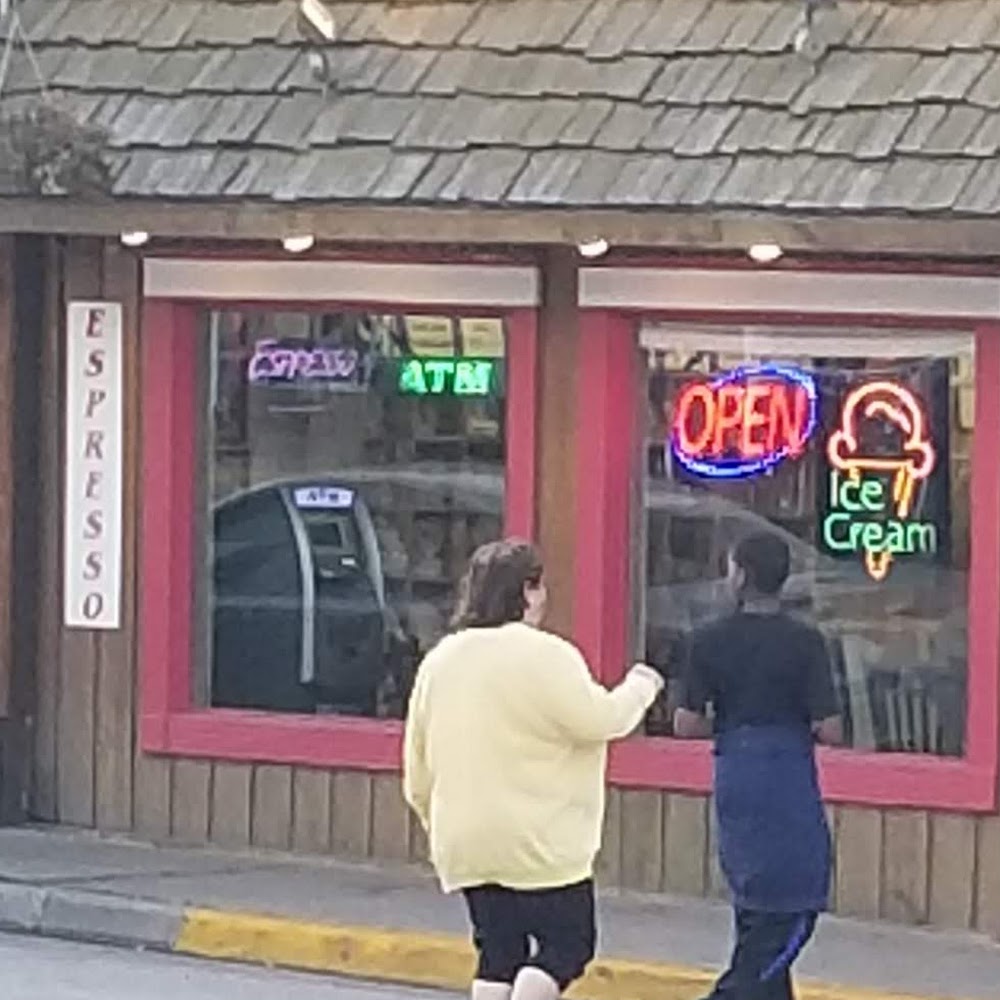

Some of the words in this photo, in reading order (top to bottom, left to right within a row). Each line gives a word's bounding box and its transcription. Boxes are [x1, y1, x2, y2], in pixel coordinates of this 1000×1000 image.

[401, 359, 494, 394] ATM
[676, 382, 810, 458] OPEN
[81, 307, 107, 621] ESPRESSO
[829, 468, 886, 512] Ice
[823, 512, 937, 554] Cream
